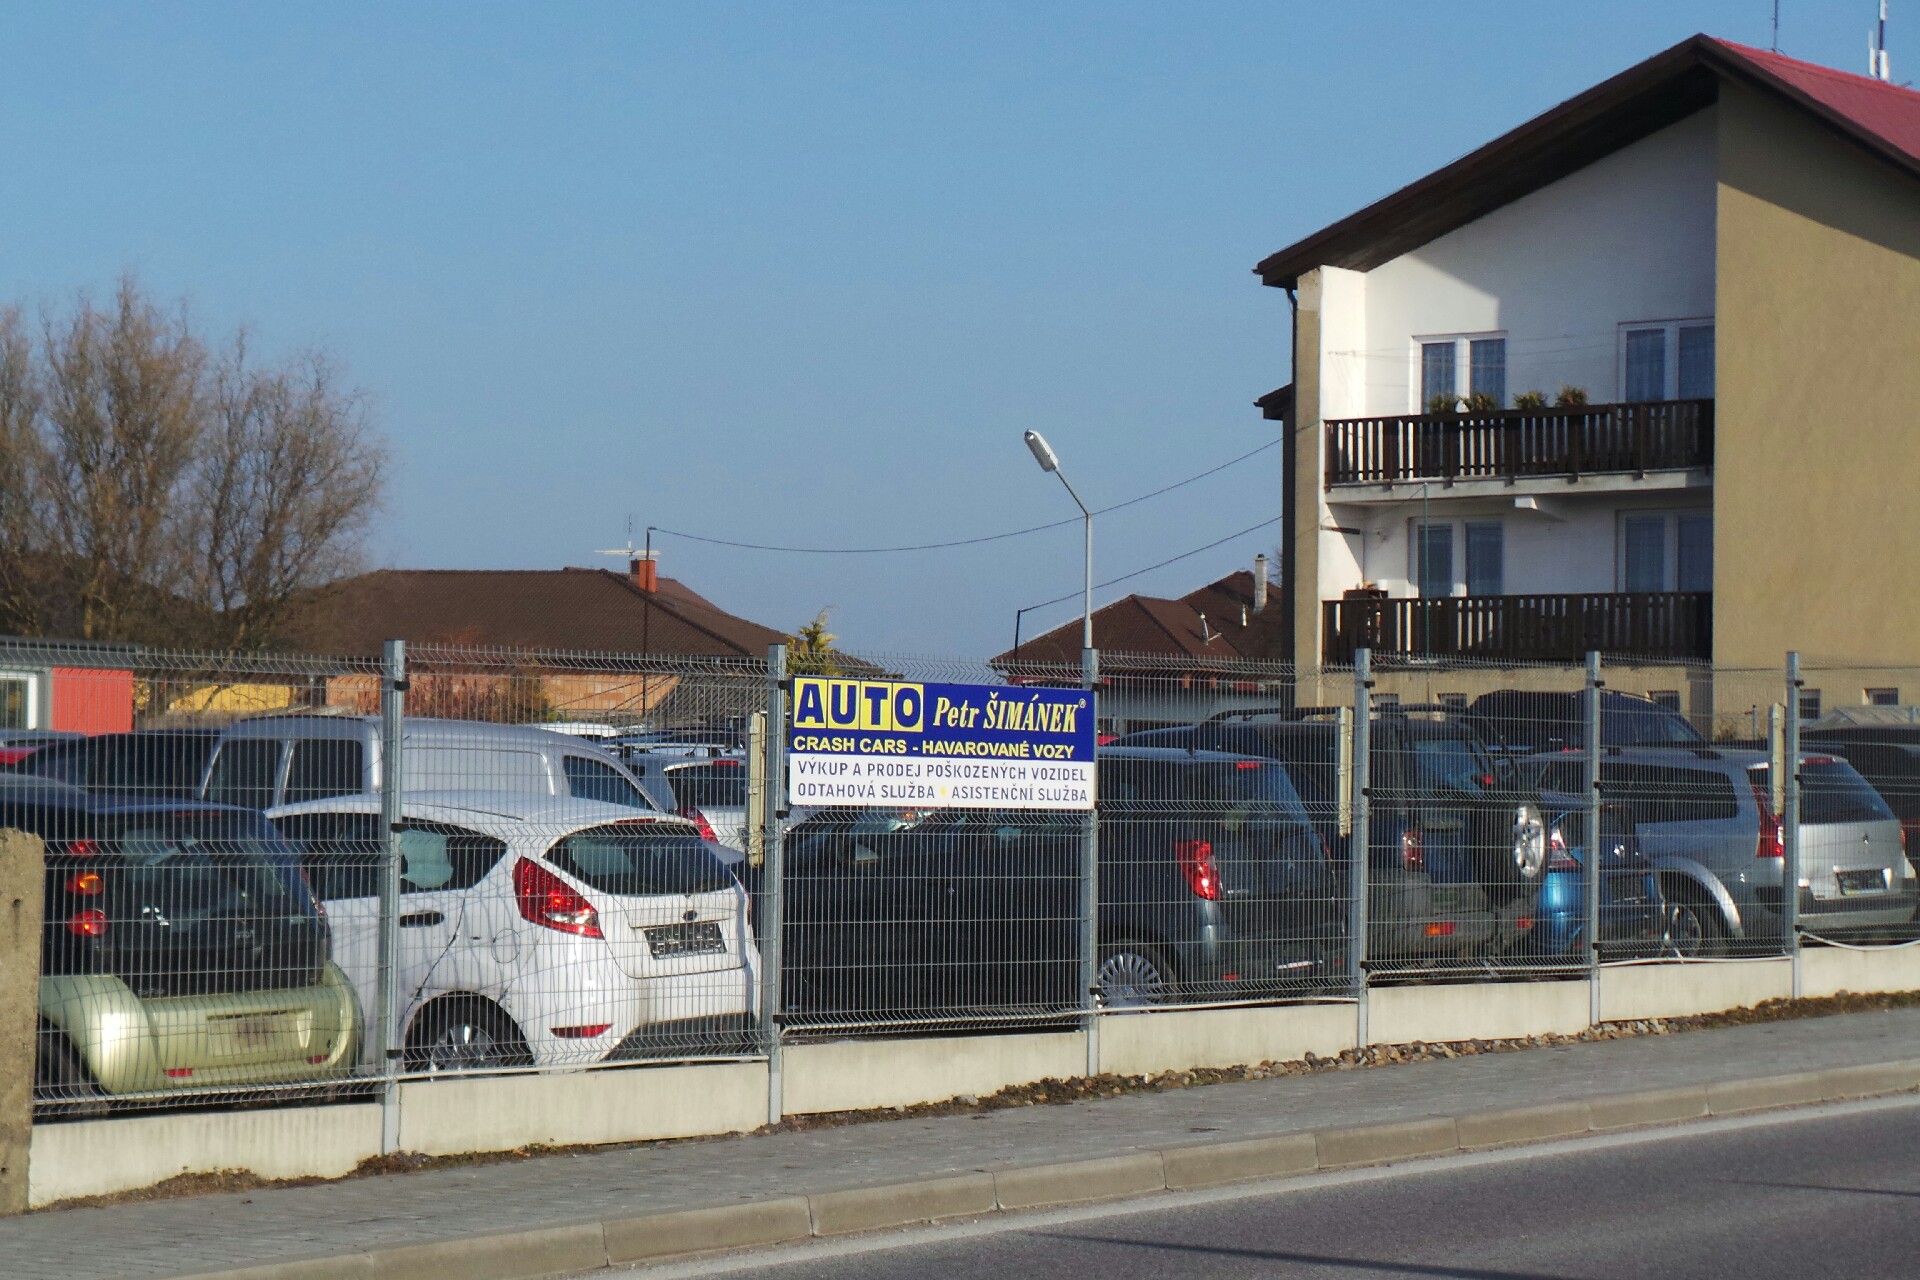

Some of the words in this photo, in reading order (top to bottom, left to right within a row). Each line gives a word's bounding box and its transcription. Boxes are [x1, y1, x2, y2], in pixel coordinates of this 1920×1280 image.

[796, 683, 921, 728] AUTO
[933, 697, 980, 728] Petr
[793, 736, 855, 752] CRASH
[859, 738, 907, 753] CARS
[922, 740, 1030, 758] HAVAROVANÉ
[1033, 744, 1075, 759] VOZY
[798, 756, 848, 776] VÝKUP
[853, 762, 861, 776] A
[867, 763, 921, 777] PRODEJ
[926, 760, 1026, 780] POŠKOZENÝCH
[1031, 767, 1087, 781] VOZIDEL
[797, 780, 876, 798] ODTAHOVÁ
[881, 781, 935, 799] SLUŽBA
[952, 783, 1034, 801] ASISTENČNÍ
[1038, 785, 1088, 802] SLUŽBA
